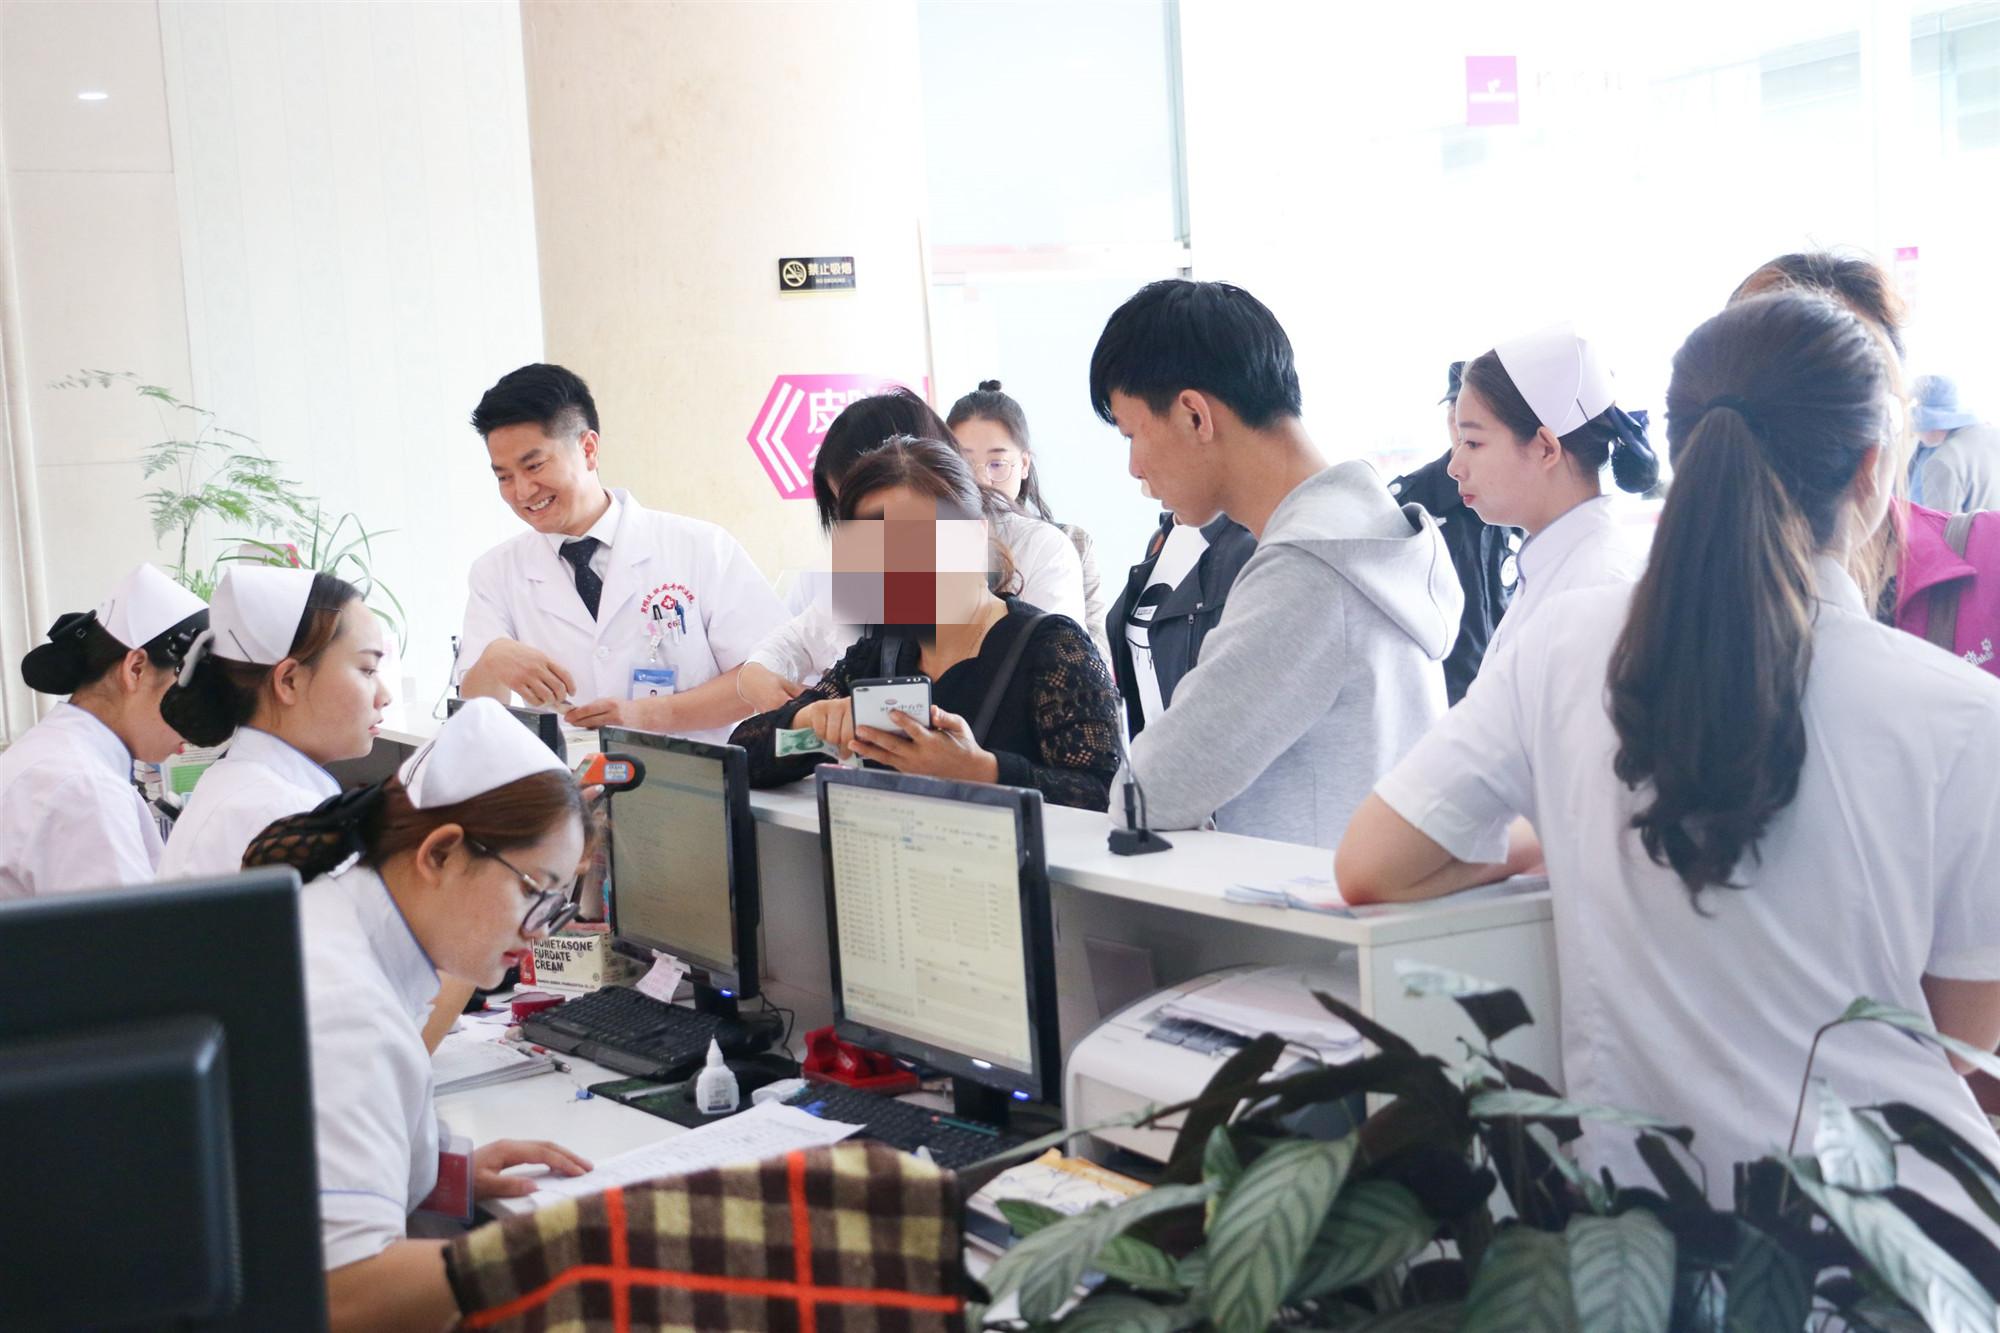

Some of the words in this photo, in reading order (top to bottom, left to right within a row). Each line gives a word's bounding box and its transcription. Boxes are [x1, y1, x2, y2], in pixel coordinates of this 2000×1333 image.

[807, 262, 852, 276] 禁止吸烟
[534, 948, 572, 962] FUROATE
[534, 959, 565, 972] CREAM
